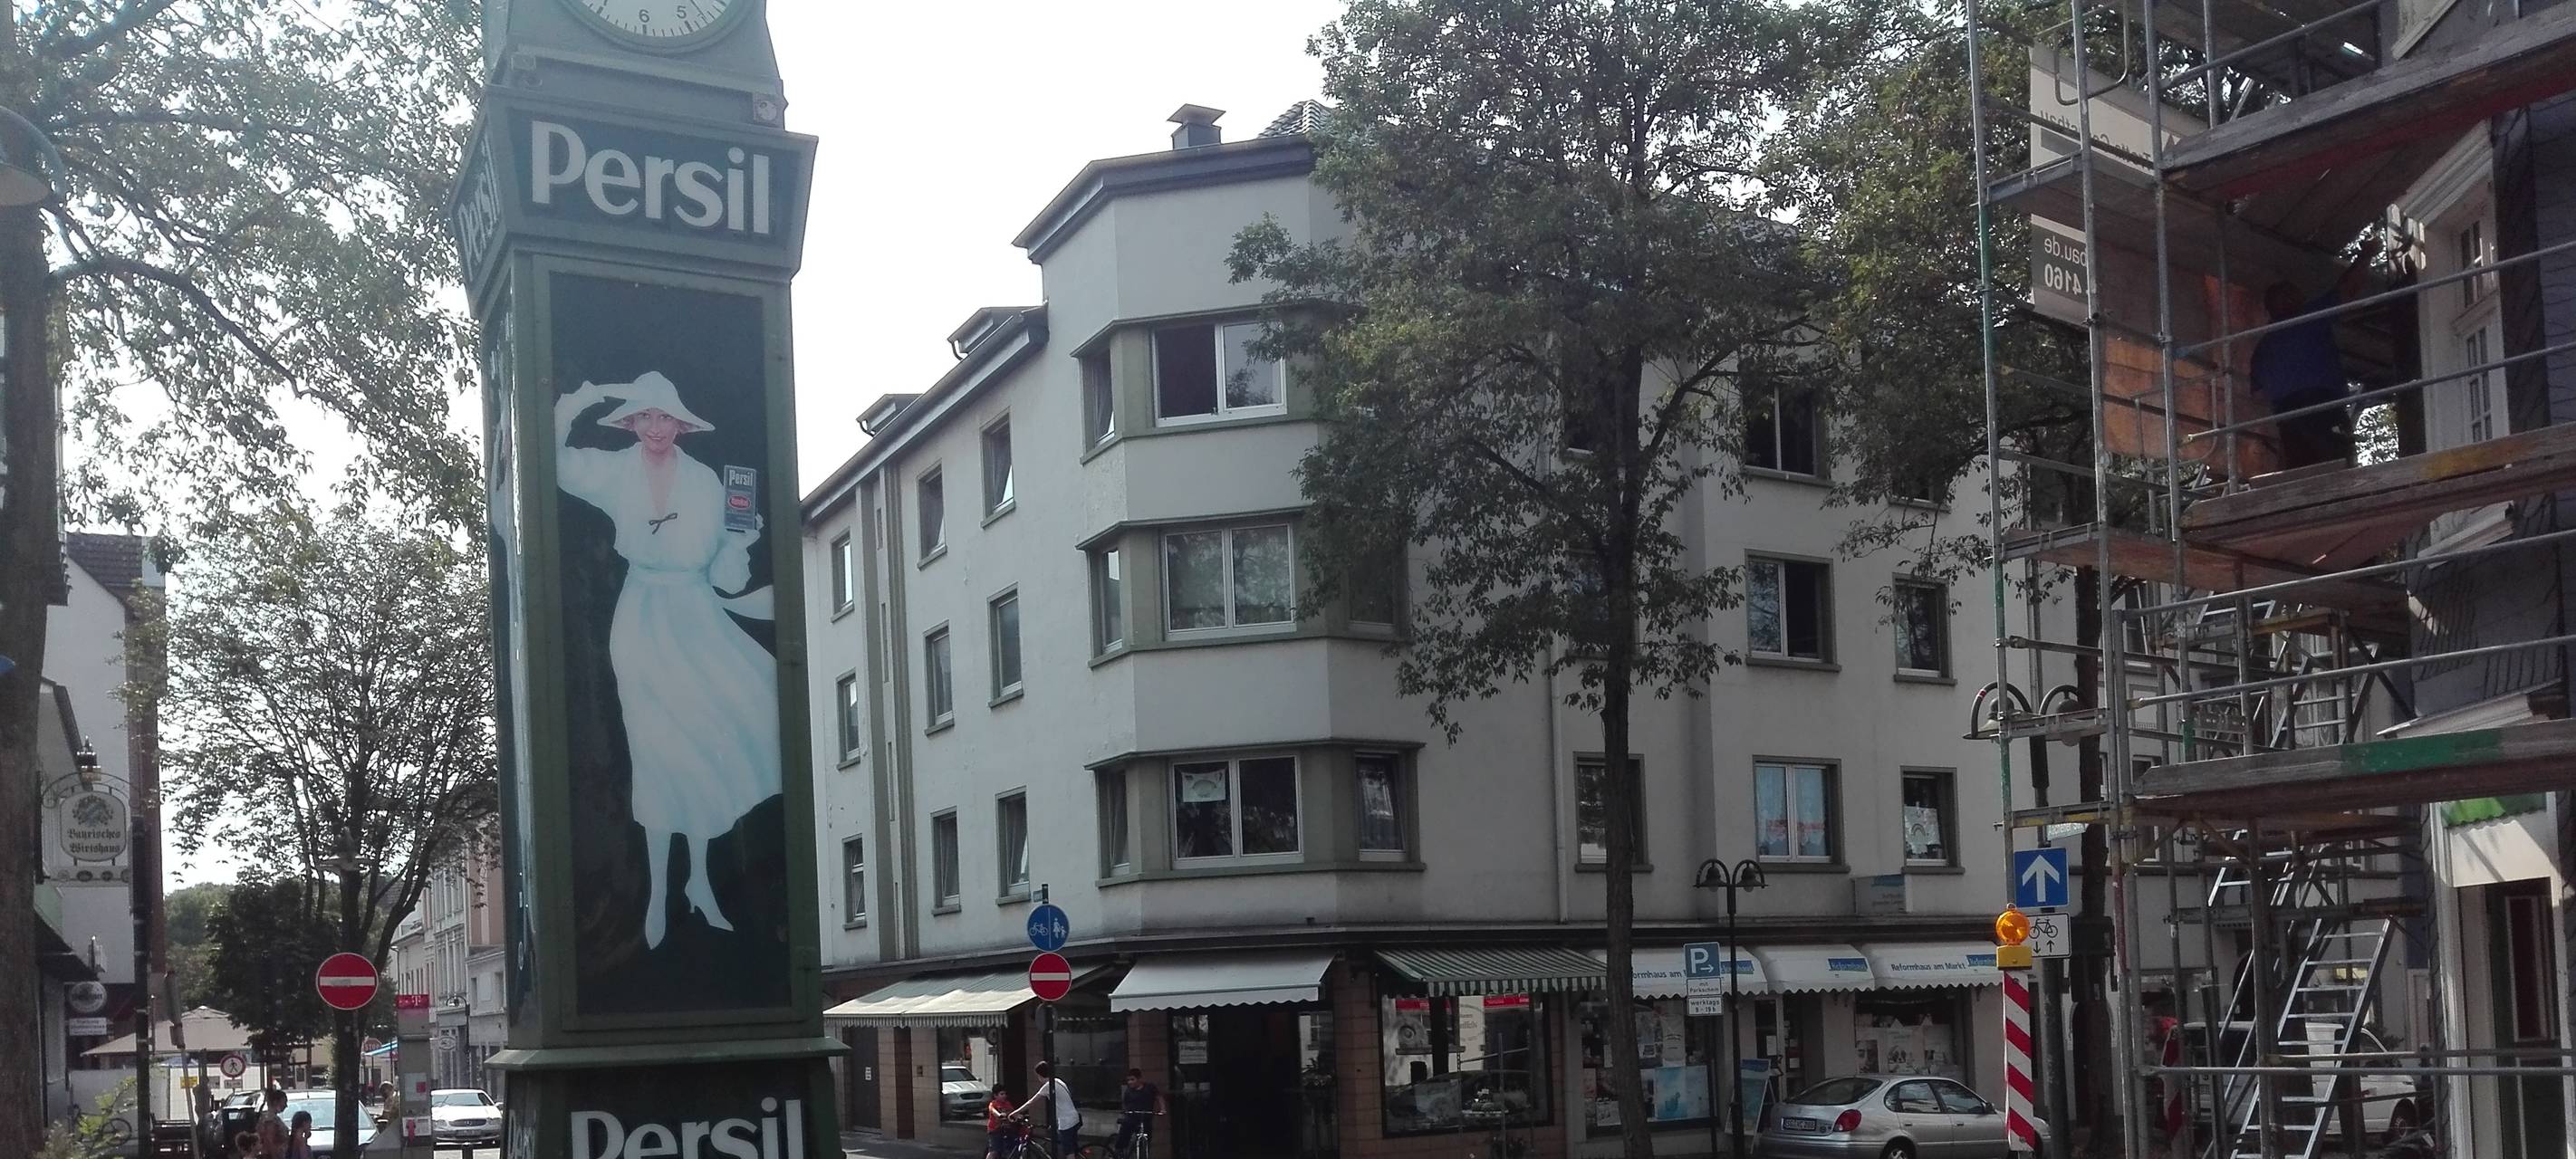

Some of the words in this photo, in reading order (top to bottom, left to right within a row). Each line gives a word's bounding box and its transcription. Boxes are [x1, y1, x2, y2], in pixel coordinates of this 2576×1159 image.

[638, 9, 650, 23] 6
[676, 5, 687, 19] 5
[531, 120, 770, 235] Persil
[457, 134, 501, 283] Persil
[728, 469, 754, 486] Persil
[69, 842, 120, 854] Wirtshaus
[1690, 947, 1709, 974] P
[1890, 963, 1931, 972] Reformhaus
[1946, 962, 1966, 971] Markt
[1632, 970, 1667, 980] ormhaus
